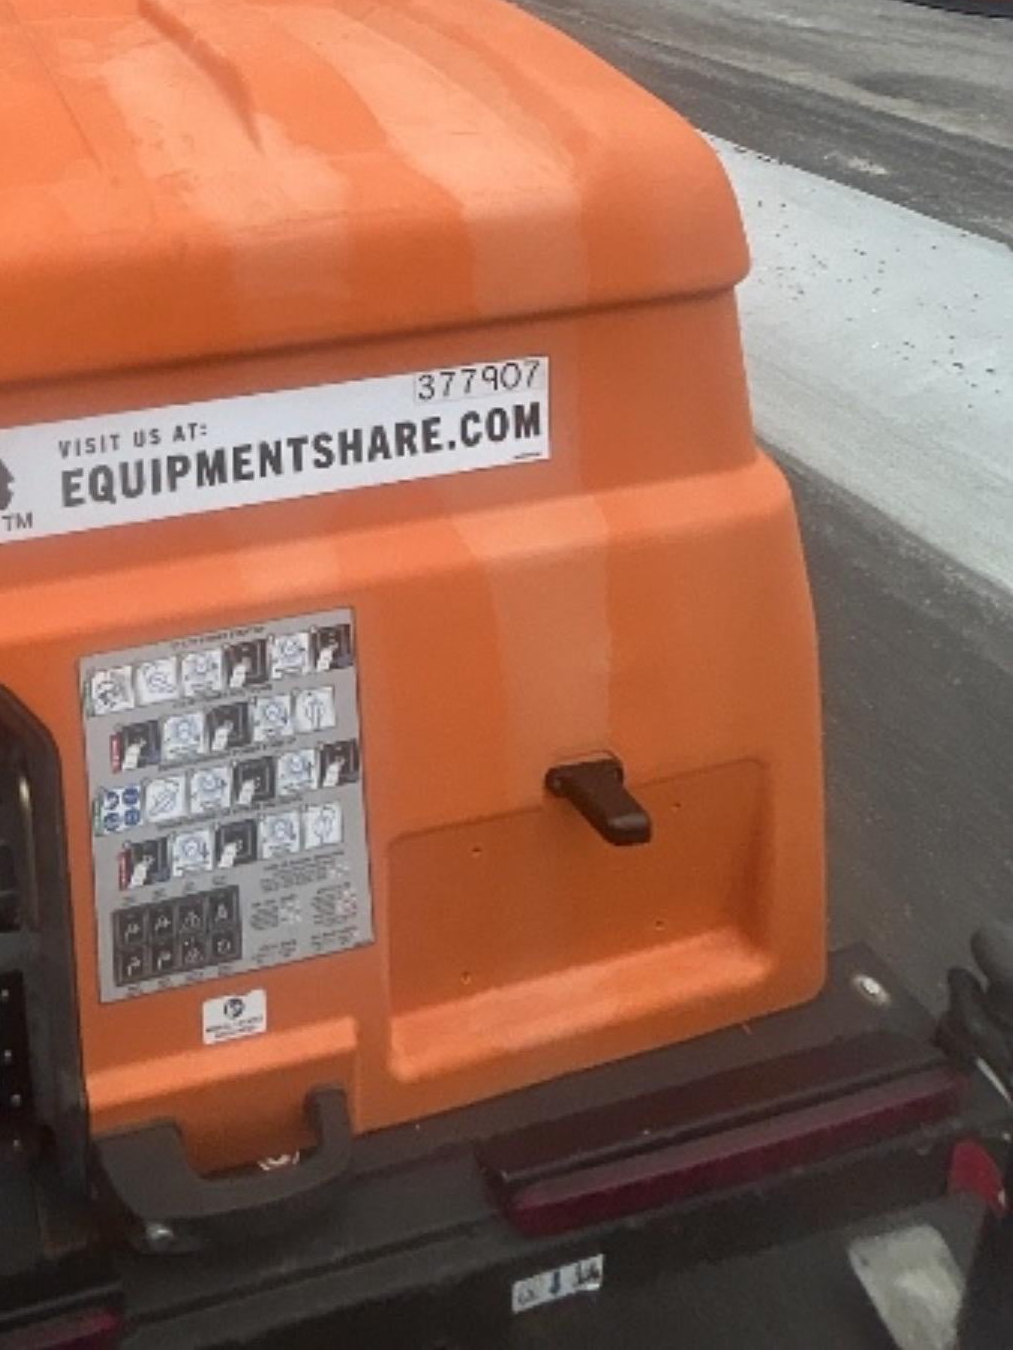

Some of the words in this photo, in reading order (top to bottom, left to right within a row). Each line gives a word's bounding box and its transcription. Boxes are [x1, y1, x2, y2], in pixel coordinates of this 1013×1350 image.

[417, 360, 540, 401] 377907
[58, 434, 121, 459] VISIT
[133, 428, 162, 449] US
[173, 422, 208, 443] AT:
[61, 402, 541, 508] EQUIPMENTSHARE.COM
[1, 511, 34, 532] TM
